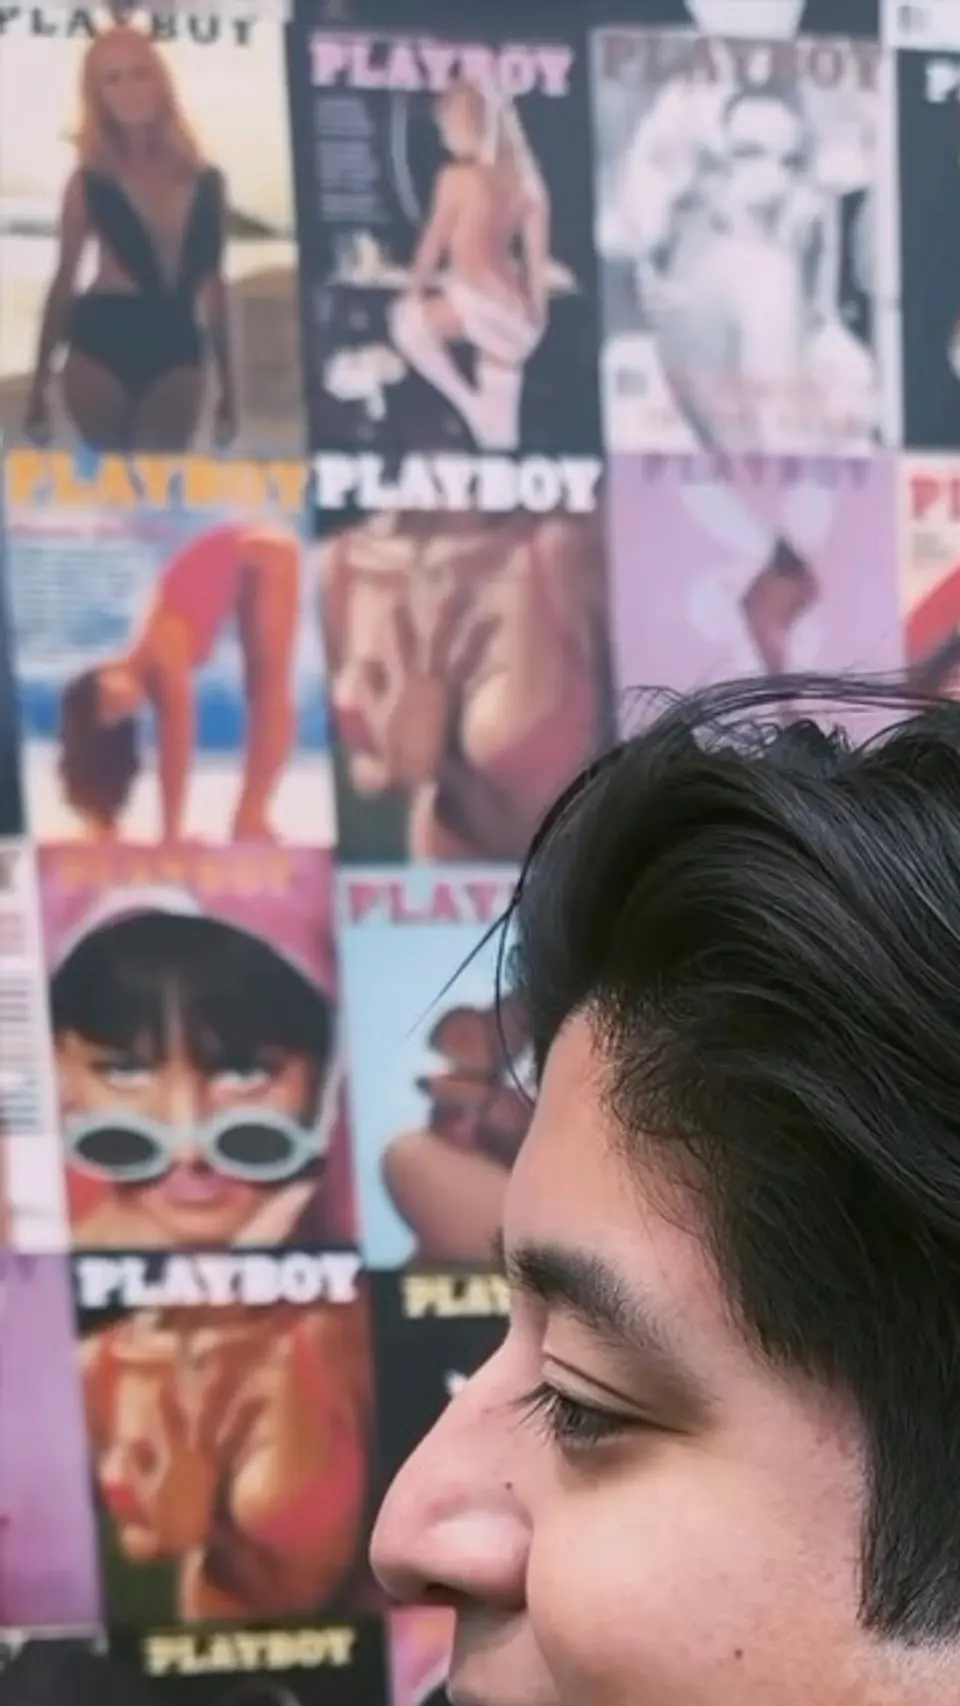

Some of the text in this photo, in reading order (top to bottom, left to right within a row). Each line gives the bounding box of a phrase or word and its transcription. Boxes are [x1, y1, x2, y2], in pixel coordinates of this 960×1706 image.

[311, 32, 574, 96] PLAYBOY
[7, 450, 306, 509] PLAYBOY
[318, 453, 602, 513] PLAYBOY
[641, 453, 872, 492] PLAYBOY
[78, 1256, 361, 1306] PLAYBOY
[145, 1629, 357, 1675] PLAYBOY
